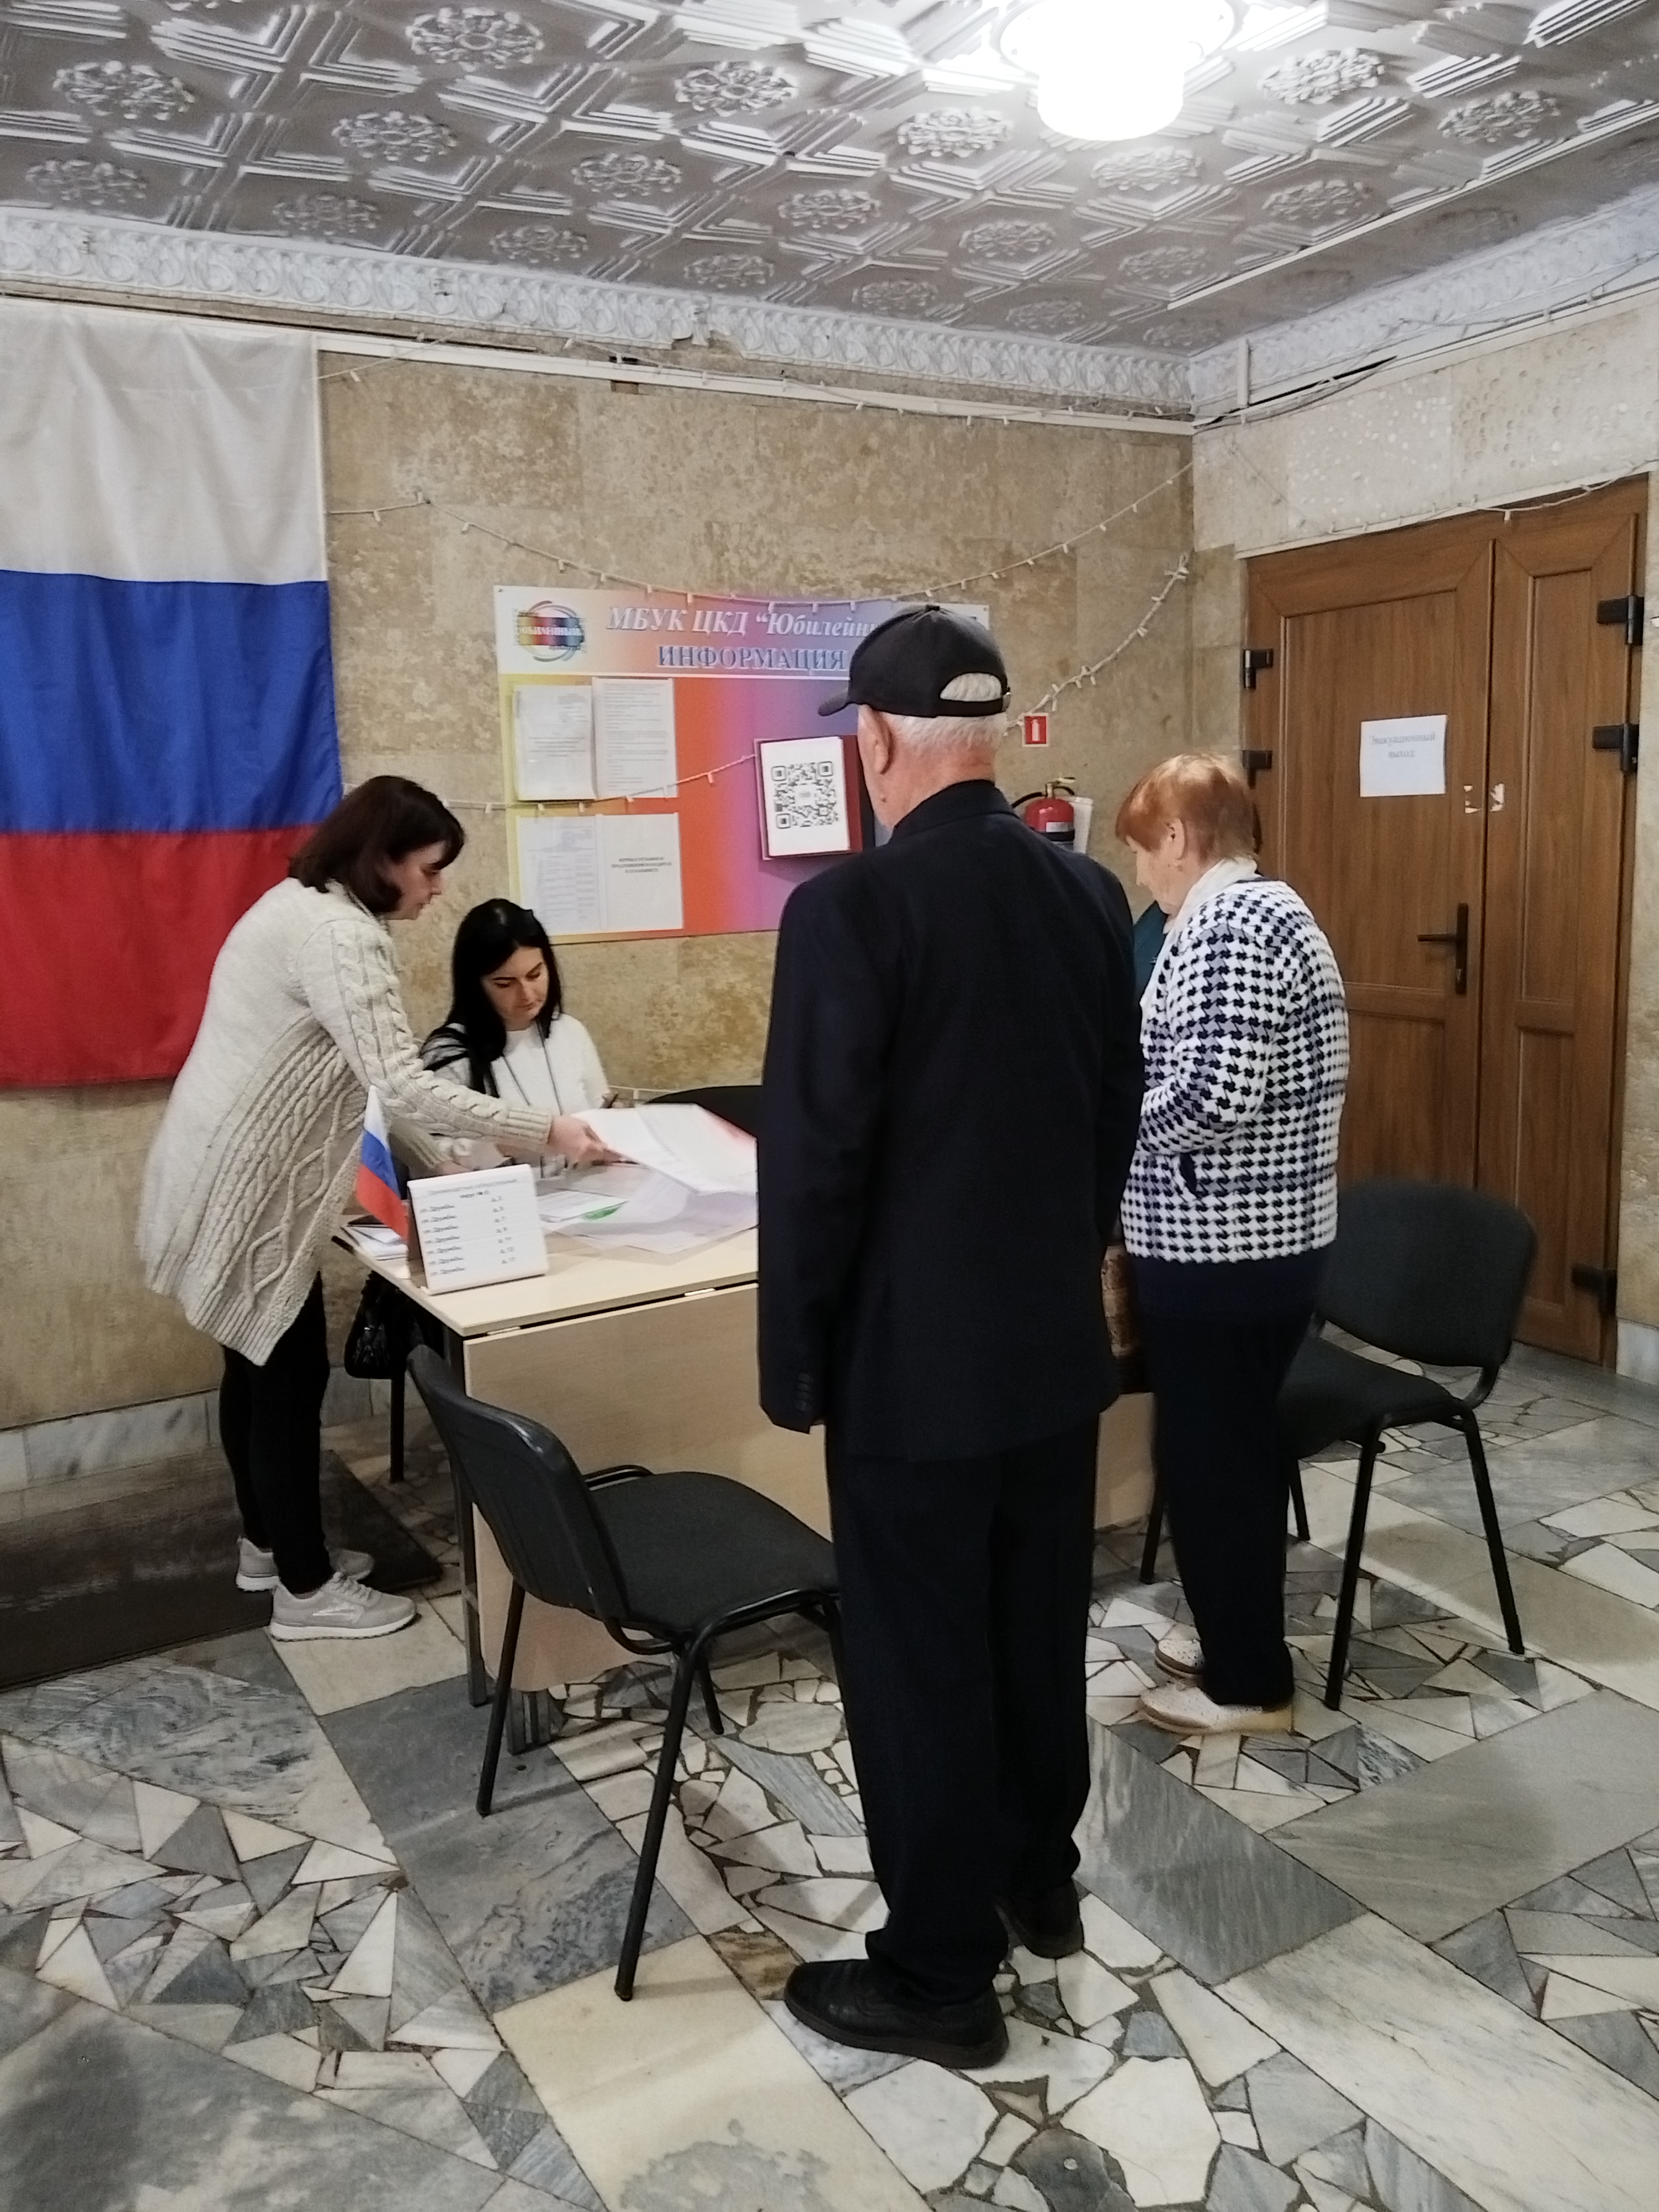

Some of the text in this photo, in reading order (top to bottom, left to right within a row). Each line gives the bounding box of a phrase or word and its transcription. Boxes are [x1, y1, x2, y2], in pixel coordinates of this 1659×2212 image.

[606, 607, 688, 631] МБУК
[691, 610, 749, 637] ЦКД
[656, 645, 848, 671] ИНФОРМАЦИЯ
[1369, 732, 1436, 745] Эвакуационный
[1388, 750, 1415, 759] выход
